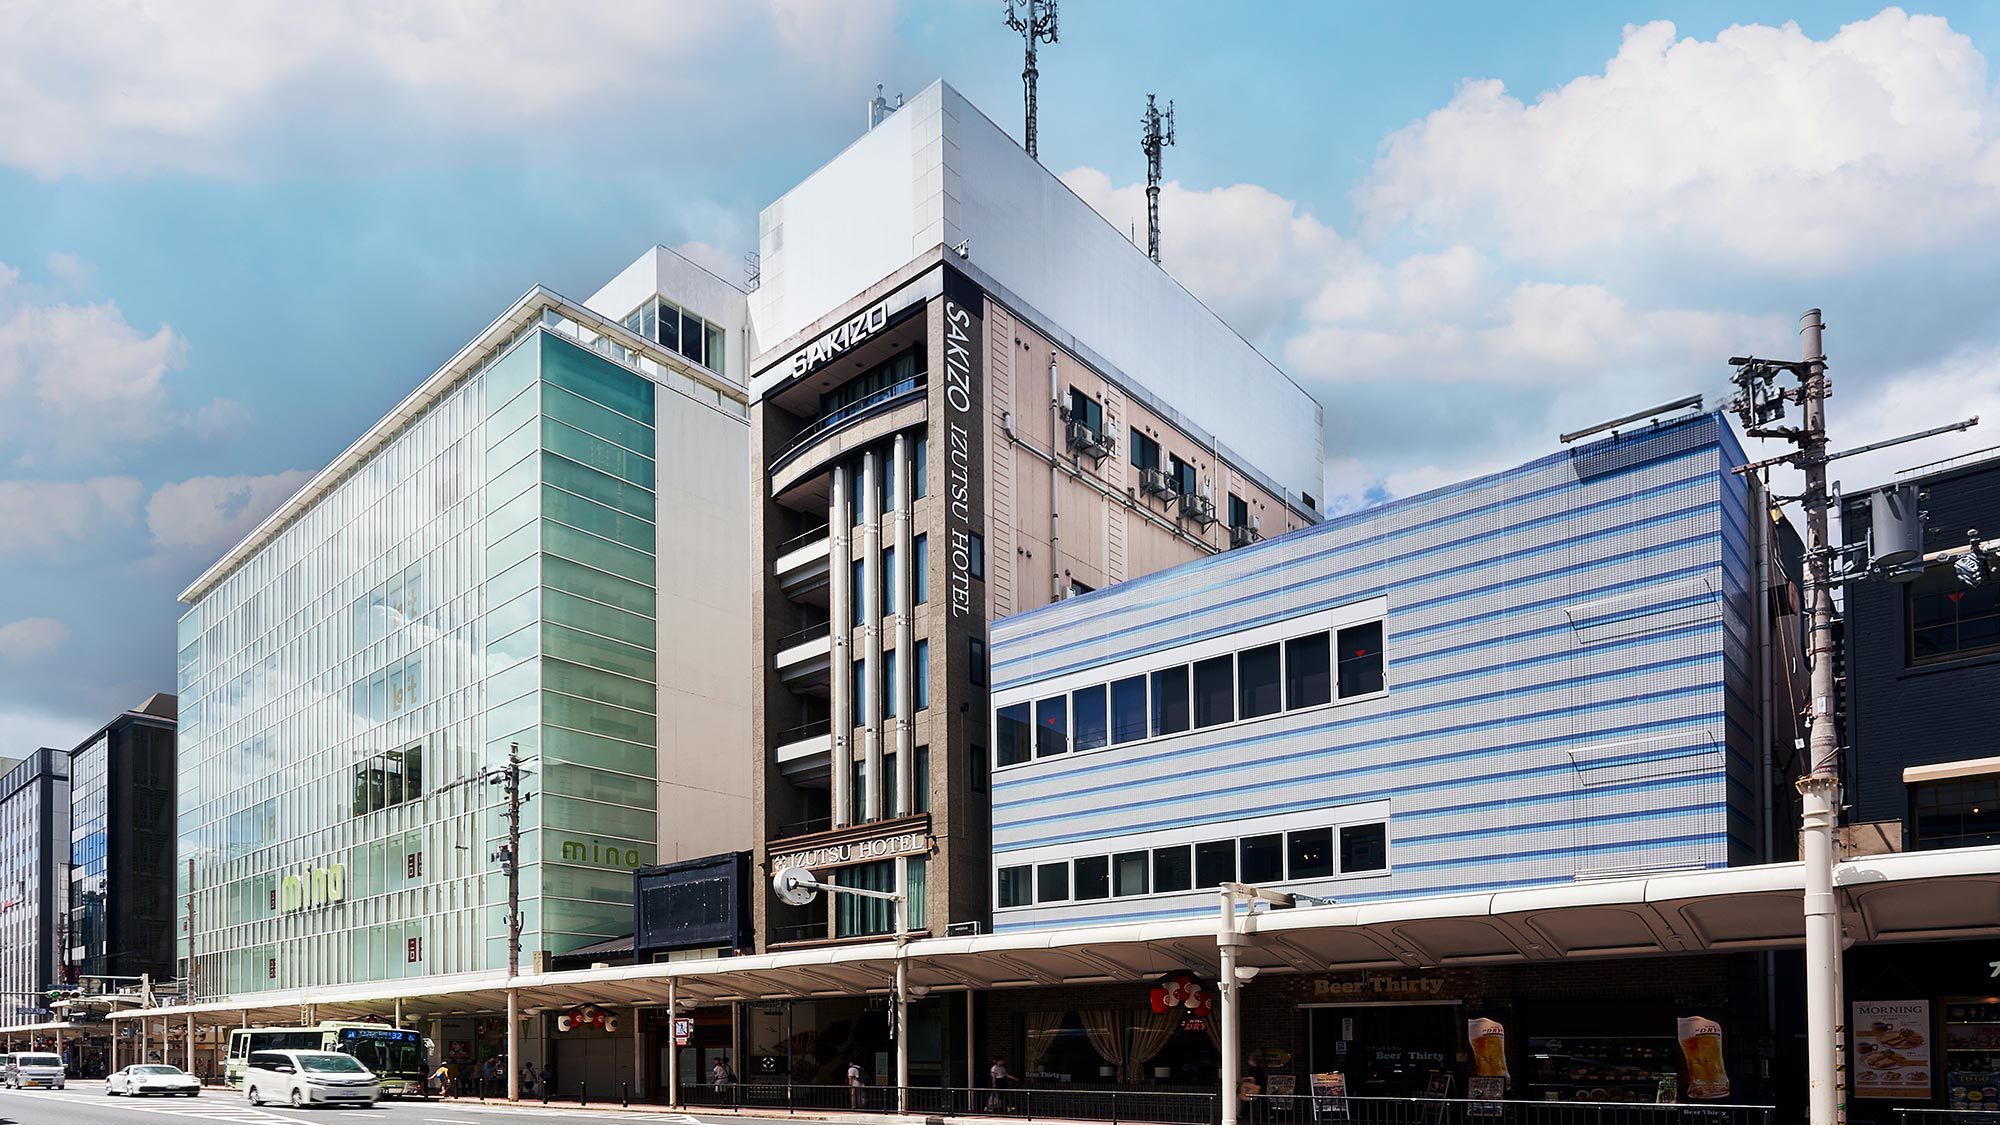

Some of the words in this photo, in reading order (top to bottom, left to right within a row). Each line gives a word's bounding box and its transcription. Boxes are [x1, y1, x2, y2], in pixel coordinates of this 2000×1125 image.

[791, 301, 889, 379] SAKIZO
[946, 301, 970, 413] SAKIZO
[951, 422, 970, 525] IZUTSU
[952, 528, 970, 618] HOTEL
[562, 840, 640, 868] mina
[790, 844, 853, 868] IZUTSU
[858, 833, 924, 858] HOTEL
[281, 862, 345, 913] mina
[1314, 978, 1364, 995] Beer
[1369, 976, 1445, 994] Thirty
[1859, 1006, 1922, 1014] MORNING
[1375, 1051, 1402, 1060] Beer
[1408, 1051, 1445, 1061] Thirty
